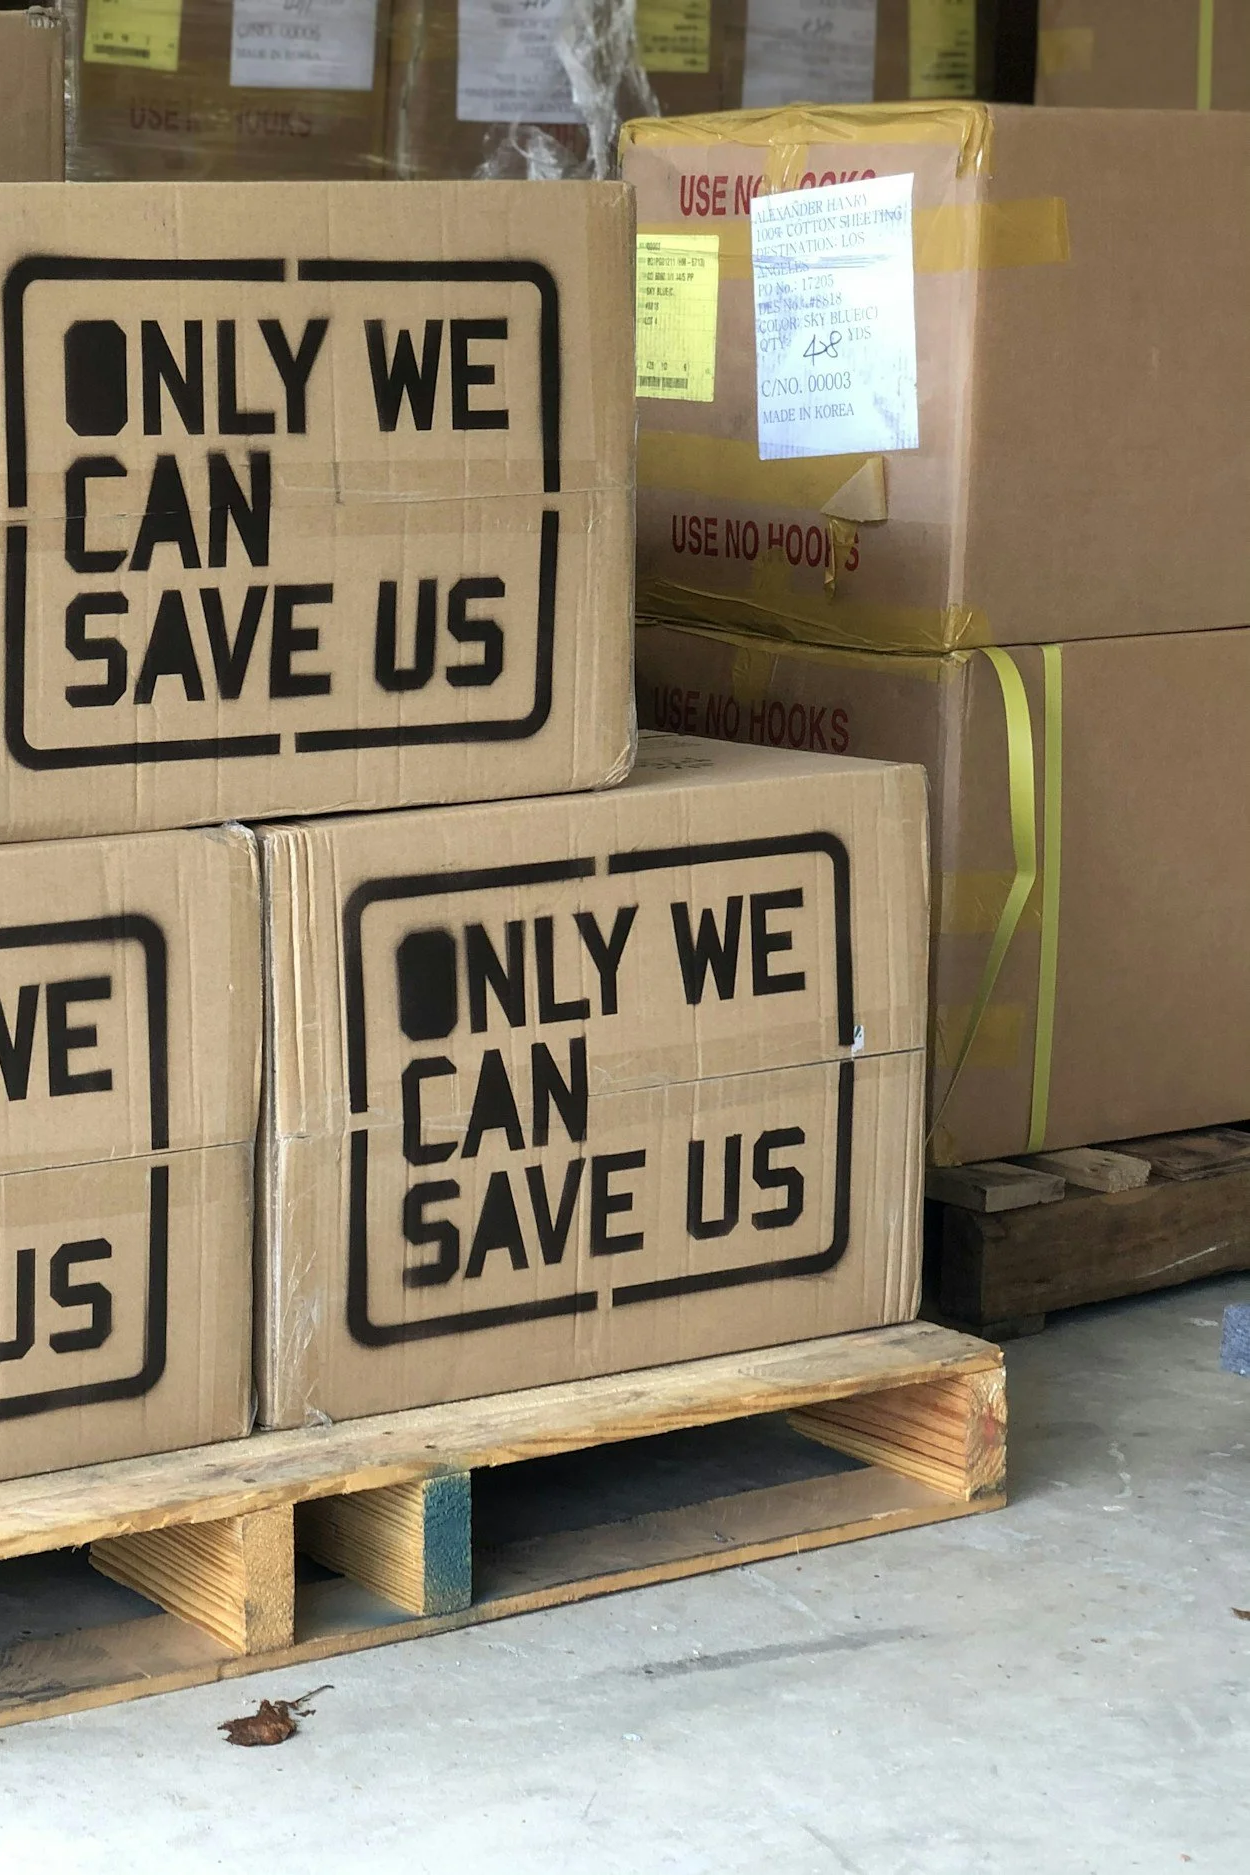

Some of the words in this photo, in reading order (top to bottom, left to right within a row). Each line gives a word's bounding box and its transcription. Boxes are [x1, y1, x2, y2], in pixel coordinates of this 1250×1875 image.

[680, 174, 729, 217] USE
[754, 200, 823, 224] ALEXANDER
[786, 217, 837, 239] COTTON
[839, 208, 903, 230] SHEETING
[756, 237, 838, 261] DESTINATION:
[841, 232, 865, 248] LOS
[758, 283, 772, 297] PO
[802, 274, 834, 291] 17205
[758, 300, 780, 316] DES
[808, 293, 842, 309] #8818
[758, 315, 800, 334] COLOR:
[804, 312, 827, 329] SKY
[830, 305, 879, 324] BLUE(C)
[847, 326, 872, 342] YDS
[64, 318, 330, 437] ONLY
[364, 318, 509, 432] WE
[761, 377, 803, 398] C/NO.
[808, 370, 852, 392] 00003
[762, 408, 796, 425] MADE
[799, 406, 811, 420] IN
[814, 402, 855, 419] KOREA
[64, 450, 272, 574] CAN
[672, 514, 718, 557] USE
[725, 518, 759, 561] NO
[64, 582, 334, 708] SAVE
[374, 576, 506, 692] US
[653, 686, 700, 734] USE
[705, 693, 740, 740] NO
[750, 700, 849, 753] HOOKS
[396, 904, 640, 1042] ONLY
[670, 887, 806, 1006] WE
[402, 1035, 588, 1167] CAN
[402, 1148, 647, 1288] SAVE
[686, 1126, 806, 1240] US
